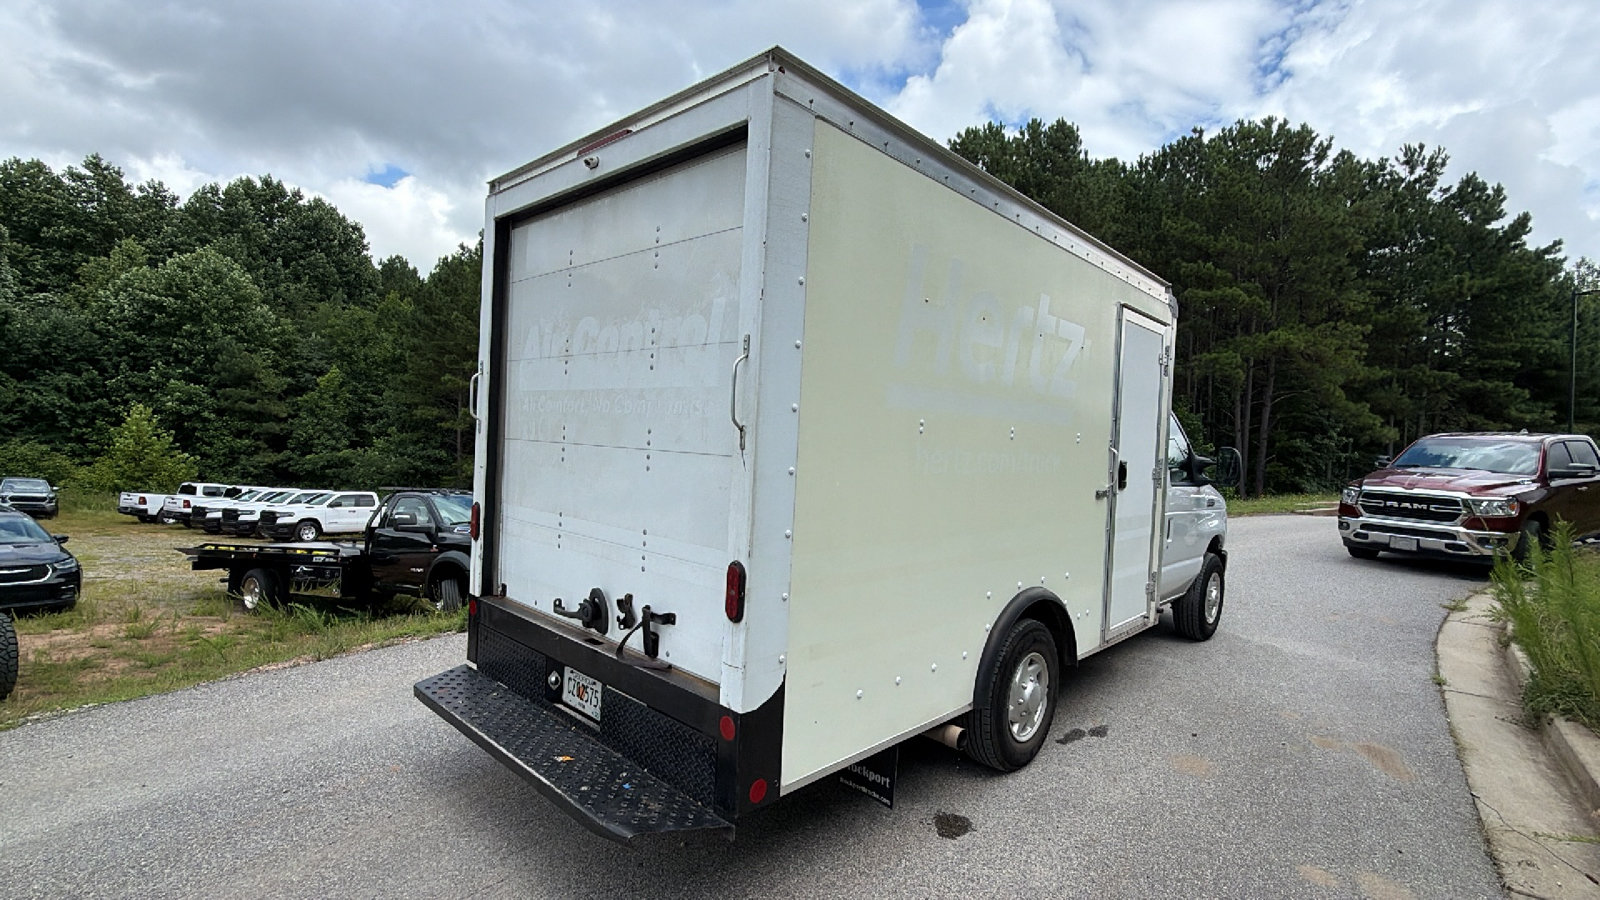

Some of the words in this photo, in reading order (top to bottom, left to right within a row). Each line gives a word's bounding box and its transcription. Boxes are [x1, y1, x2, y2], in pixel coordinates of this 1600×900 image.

[572, 298, 727, 360] Control
[892, 243, 1086, 399] Hertz
[1385, 501, 1428, 510] RAM
